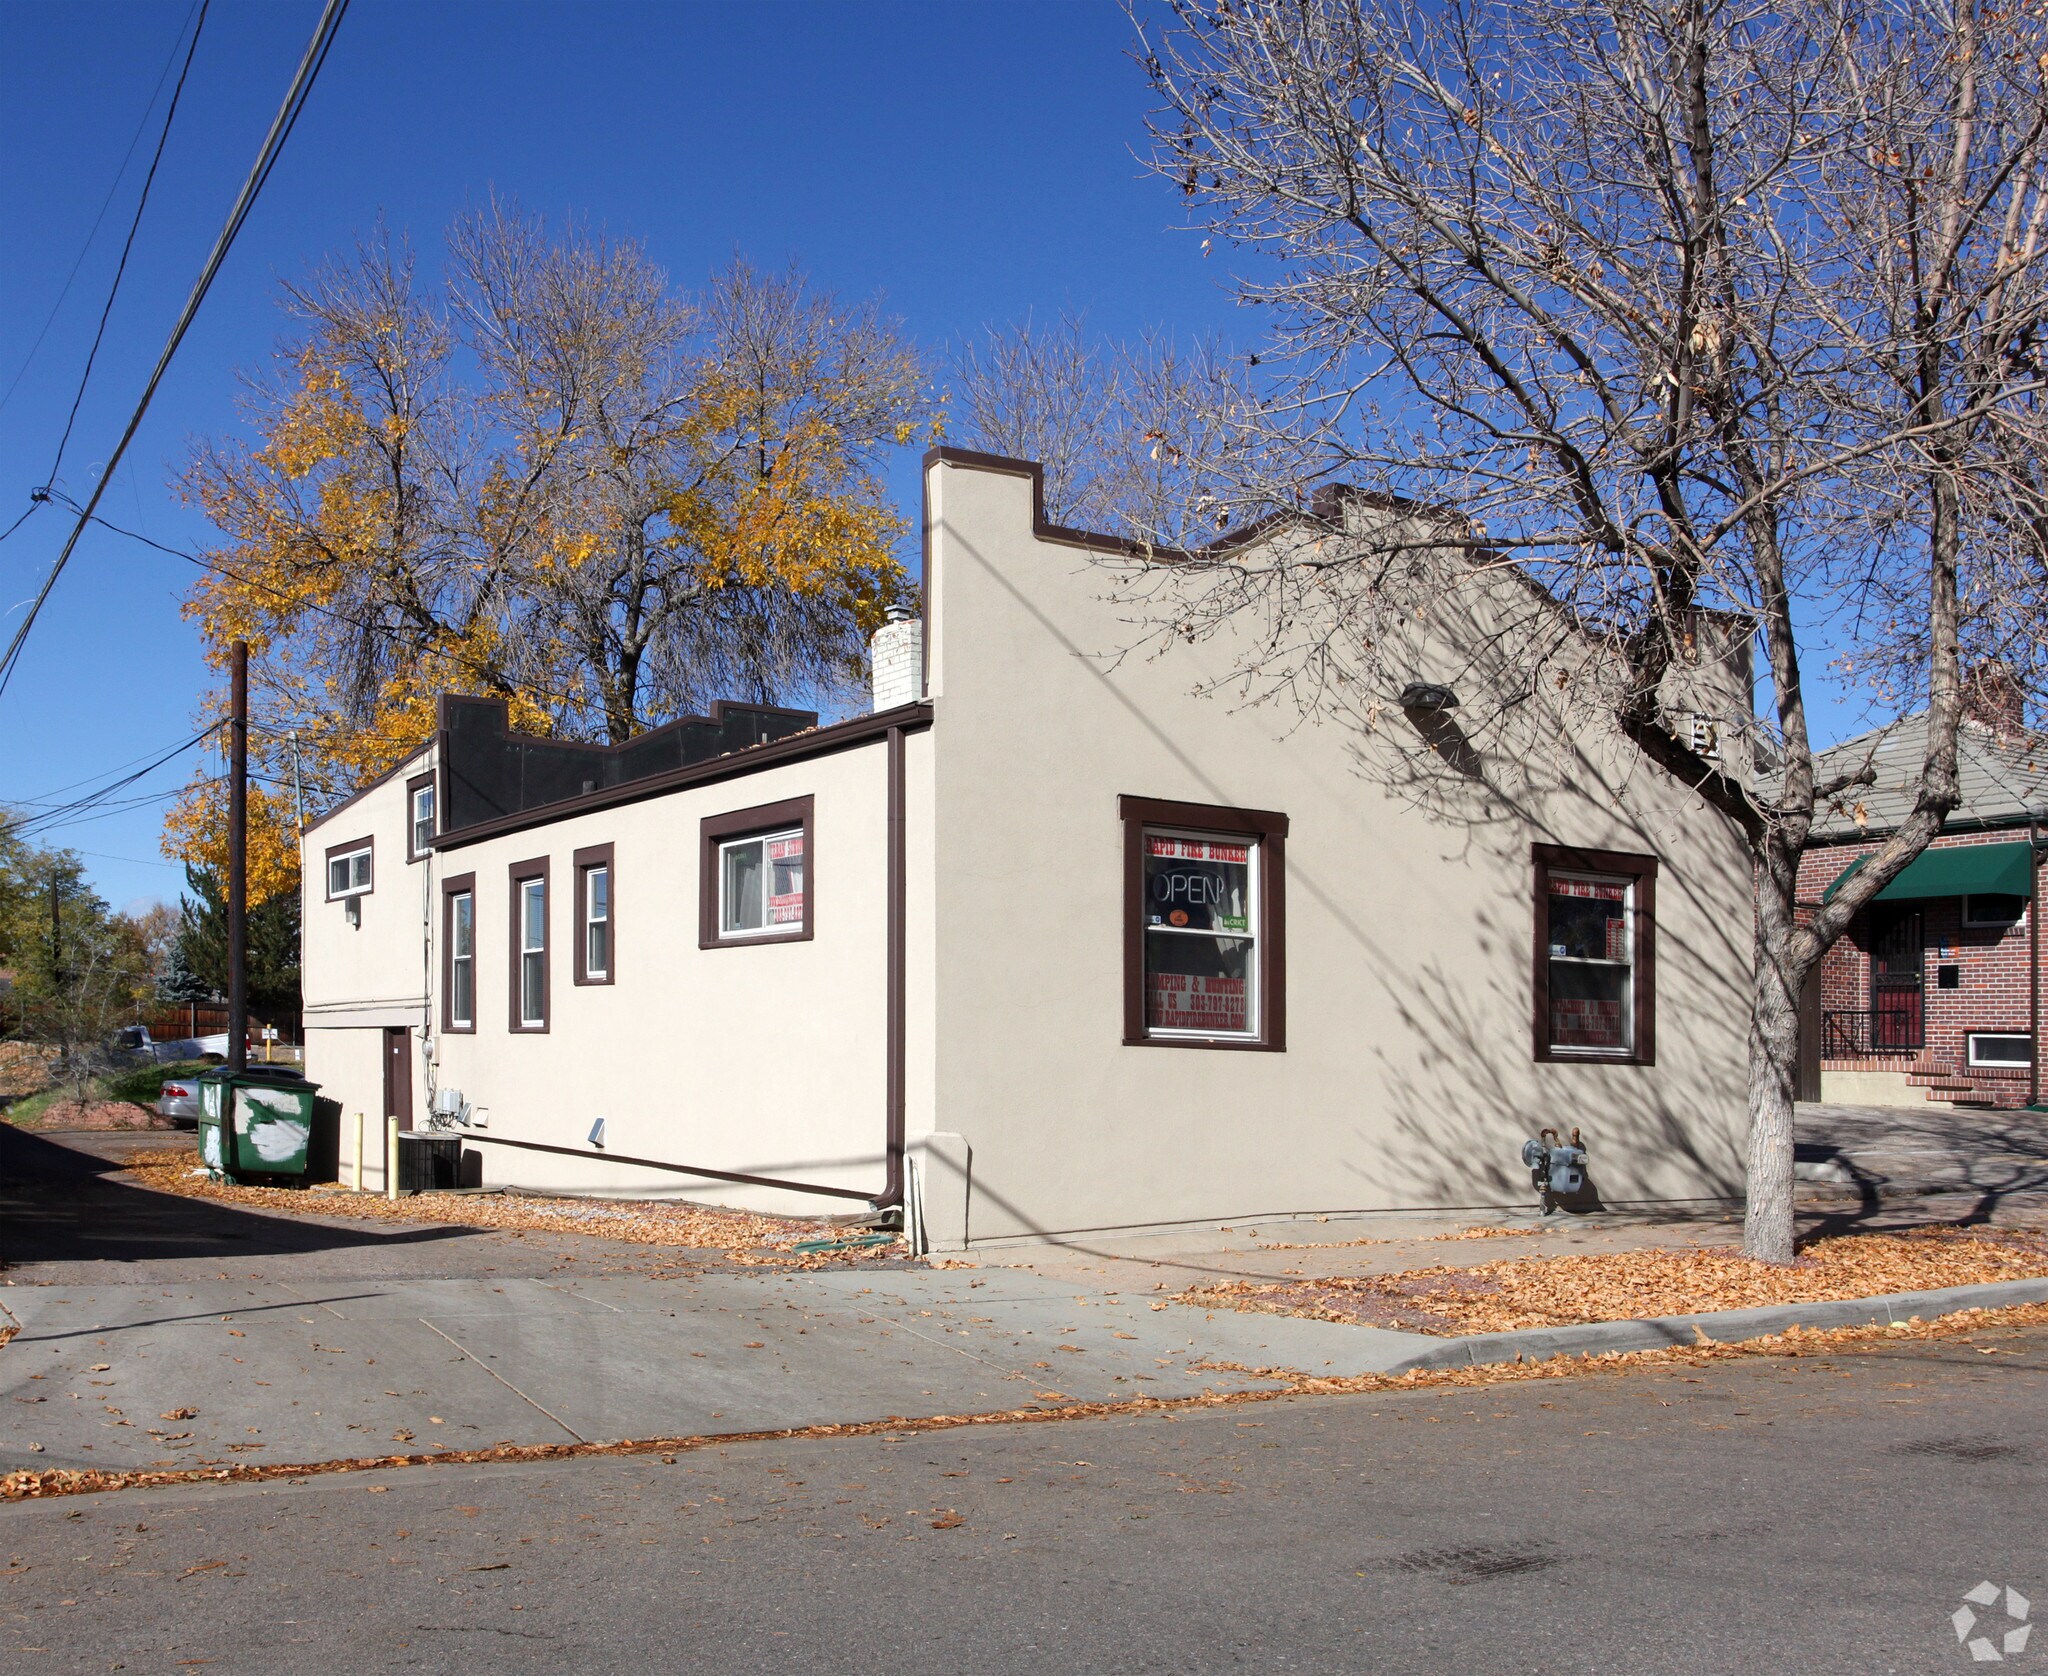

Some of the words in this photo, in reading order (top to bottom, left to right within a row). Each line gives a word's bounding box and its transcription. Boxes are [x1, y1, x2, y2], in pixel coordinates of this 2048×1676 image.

[1145, 837, 1175, 856] RAPID
[1180, 840, 1203, 859] FIRE
[1209, 842, 1247, 862] BUNKER
[1153, 874, 1221, 904] OPEN
[1191, 975, 1200, 993] &
[1168, 992, 1177, 1010] US
